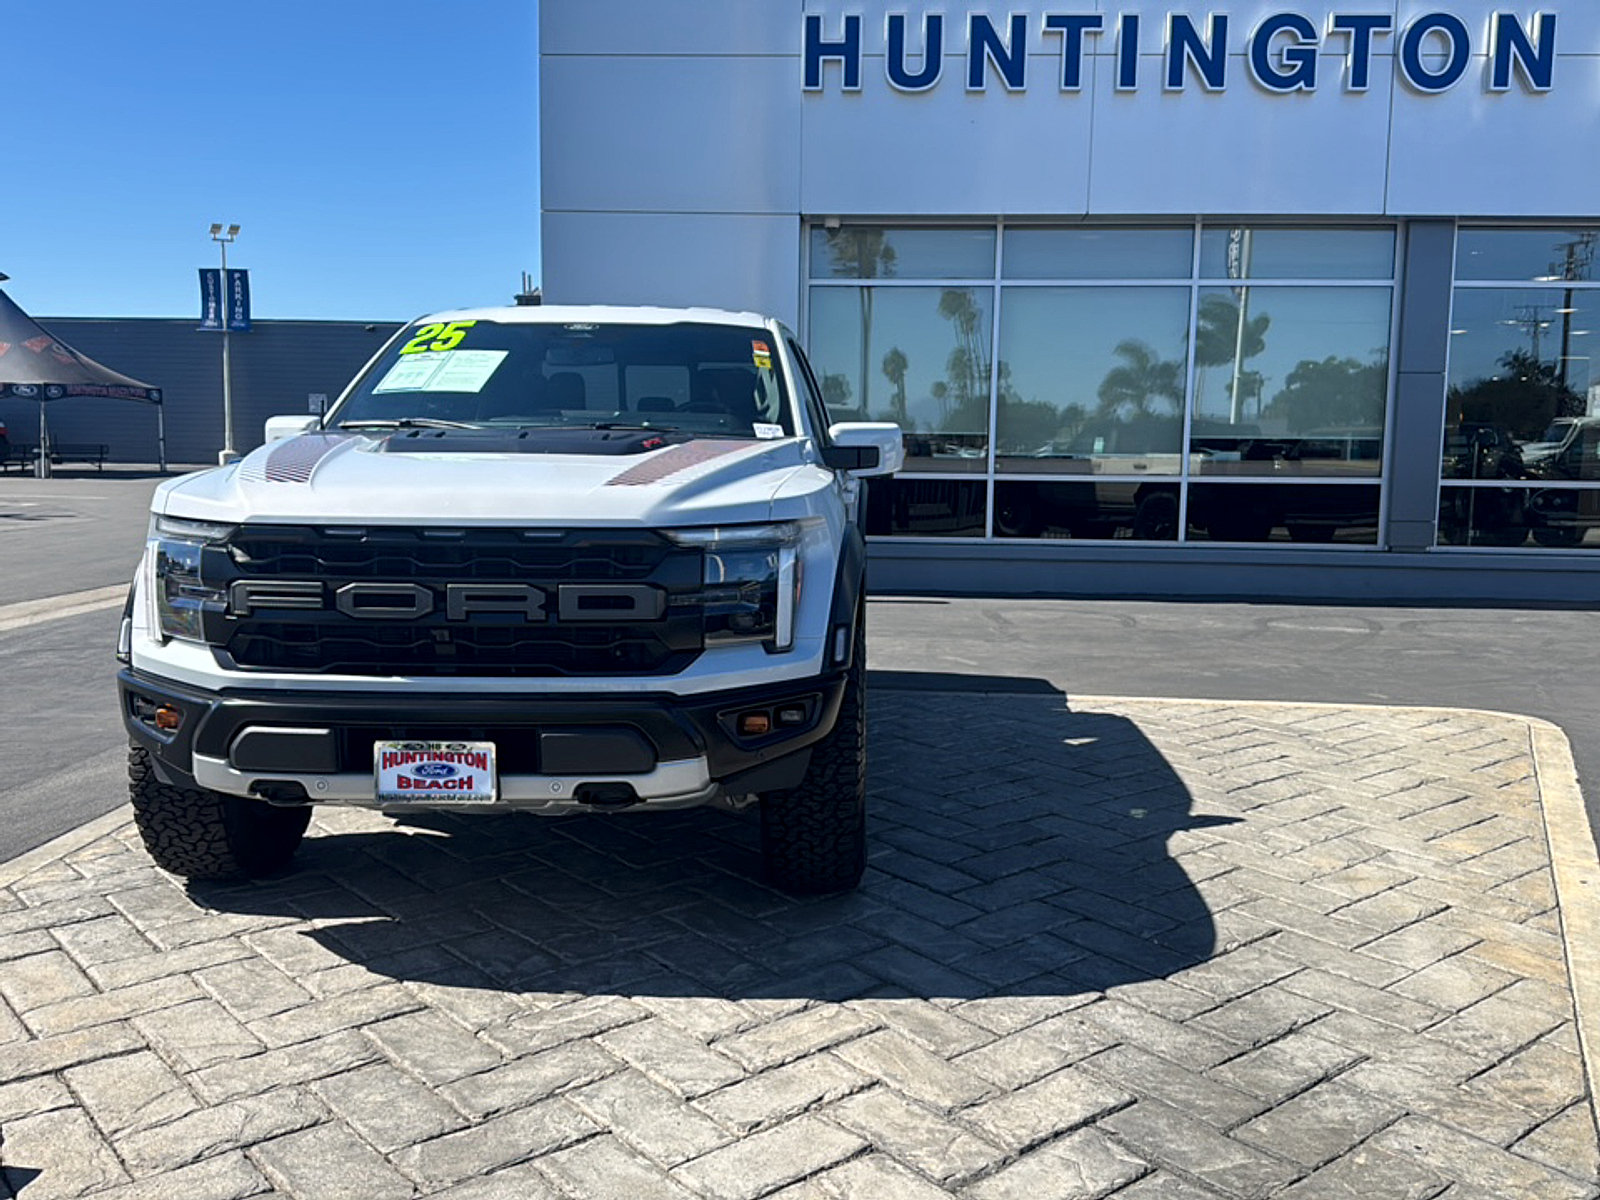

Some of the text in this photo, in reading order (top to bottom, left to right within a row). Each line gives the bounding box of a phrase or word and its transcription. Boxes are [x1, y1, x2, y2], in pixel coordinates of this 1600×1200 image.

[802, 12, 1558, 93] HUNTINGTON
[234, 272, 243, 320] PARKING
[399, 320, 477, 354] 25
[229, 580, 667, 621] FORD
[381, 751, 488, 772] HUNTINGTON
[397, 774, 473, 790] BEACH
